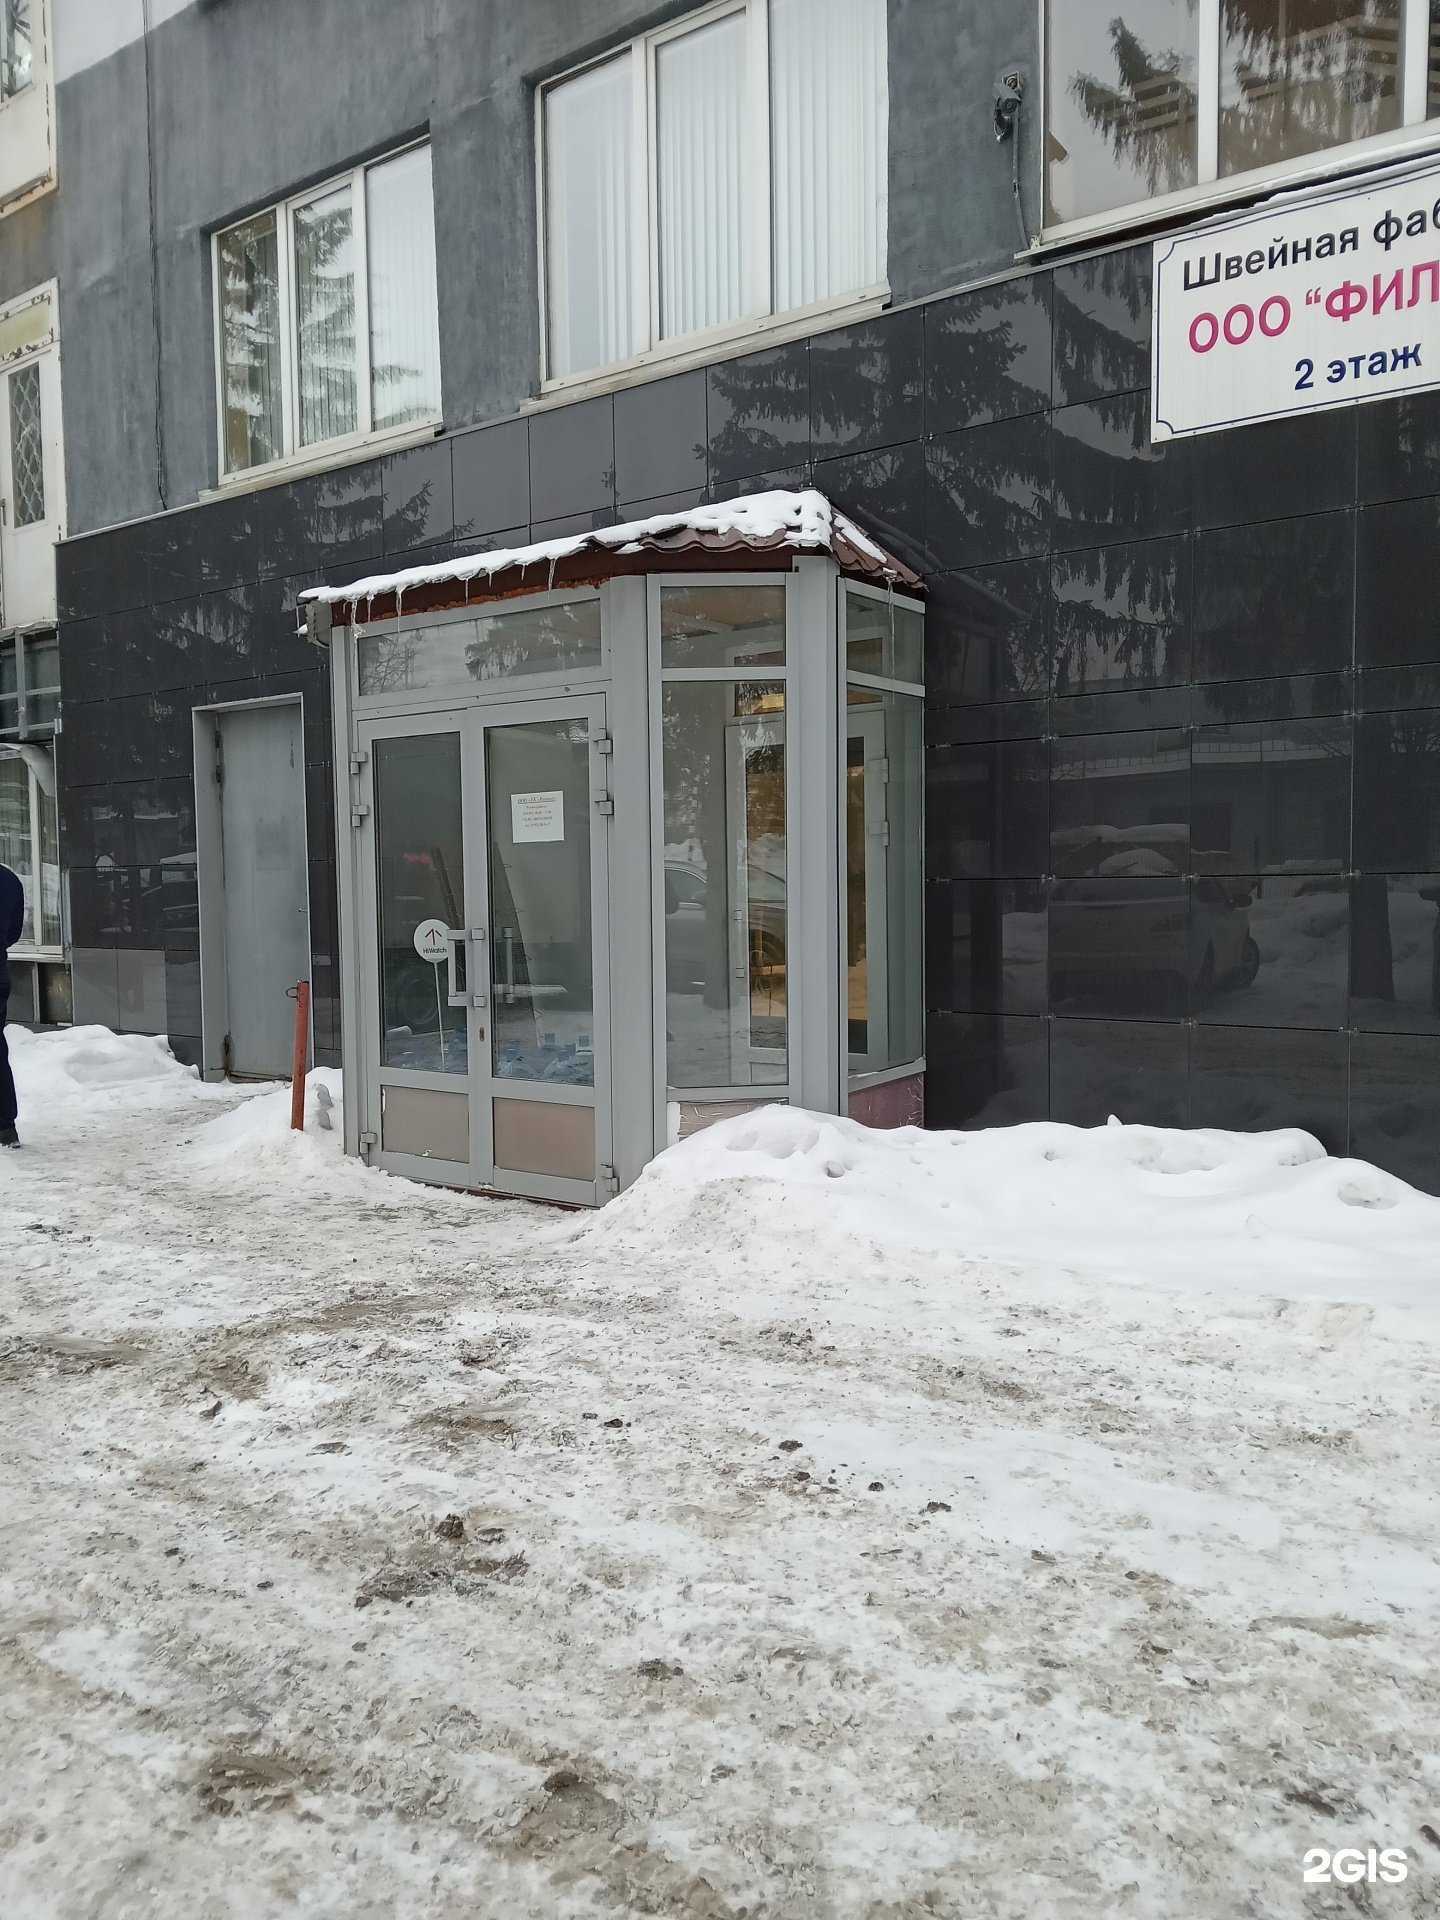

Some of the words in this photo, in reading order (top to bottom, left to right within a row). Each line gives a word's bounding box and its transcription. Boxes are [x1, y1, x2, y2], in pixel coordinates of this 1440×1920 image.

[1183, 227, 1360, 291] Швейная
[1188, 295, 1291, 353] ООО
[1294, 358, 1315, 391] 2
[1326, 343, 1422, 384] этаж
